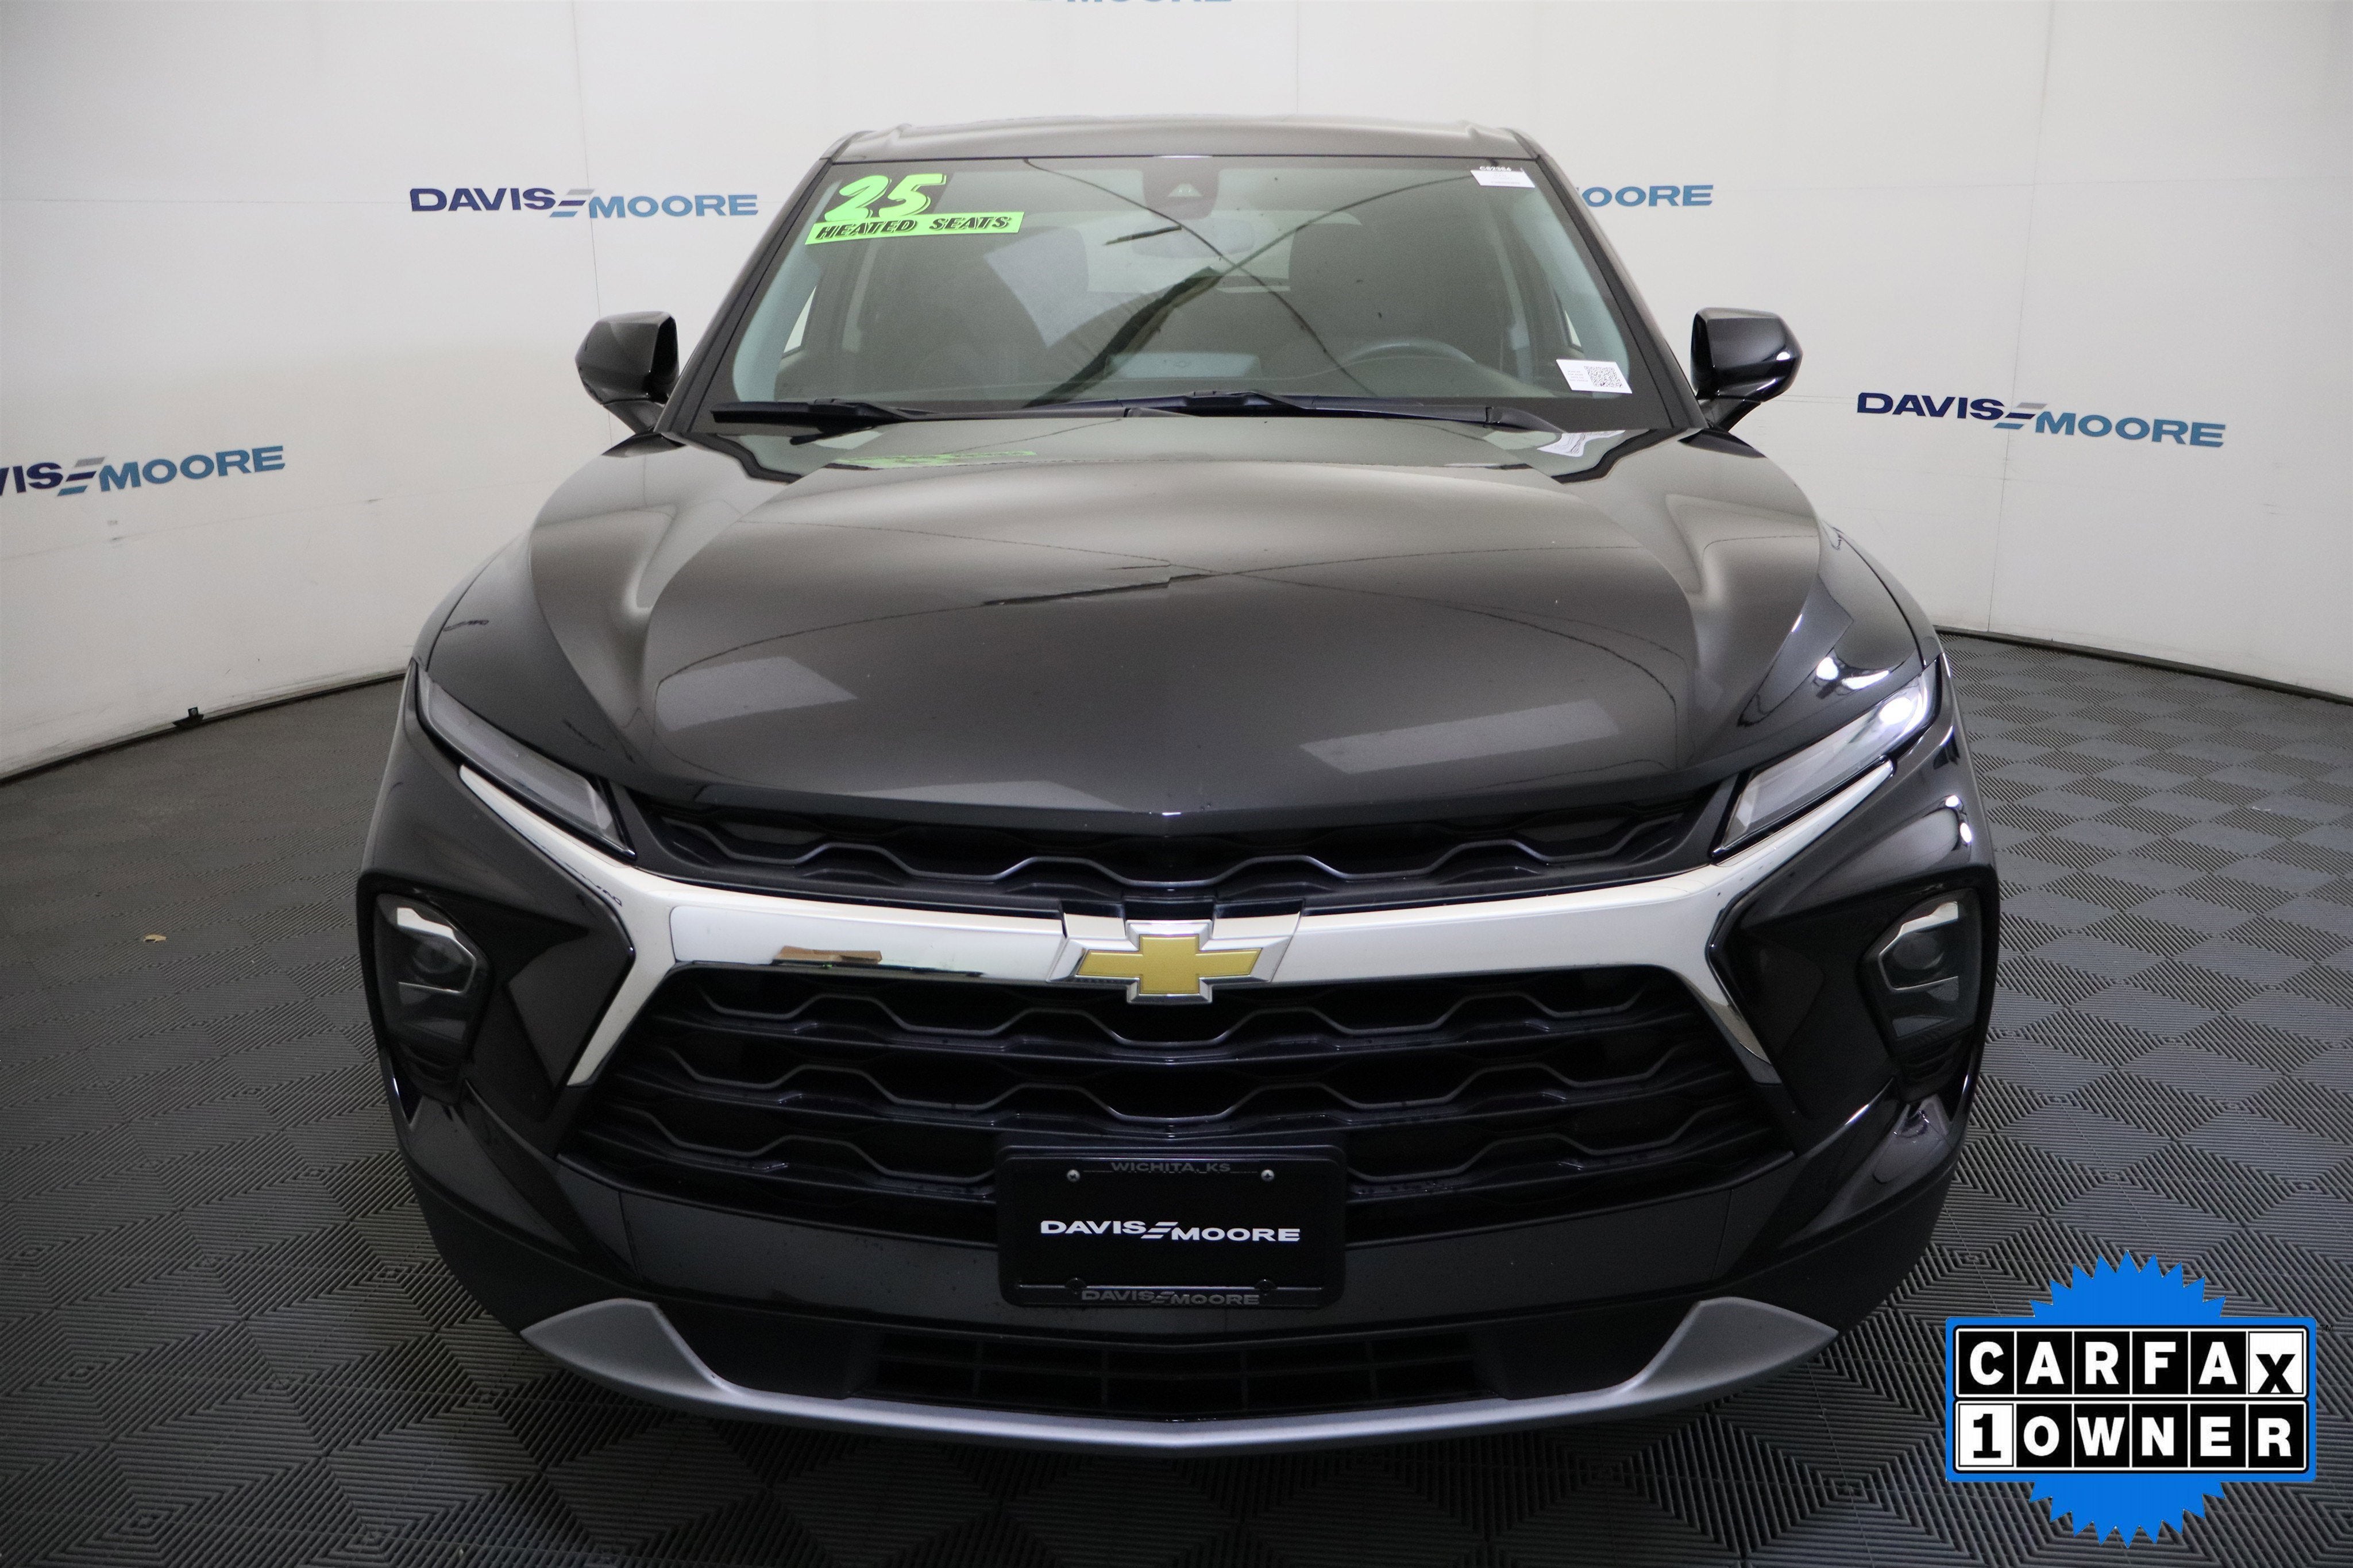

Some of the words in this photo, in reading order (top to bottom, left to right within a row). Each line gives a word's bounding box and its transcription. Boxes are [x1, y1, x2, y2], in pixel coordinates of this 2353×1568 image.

[410, 188, 555, 211] DAVIS
[589, 194, 758, 218] MOORE
[824, 173, 947, 222] 25
[1577, 184, 1714, 207] OORE
[815, 219, 918, 240] HEATED
[929, 216, 1011, 230] SEATS
[1857, 392, 2005, 420] DAVIS
[2035, 411, 2226, 448] MOORE
[99, 446, 286, 492] MOORE
[1206, 1163, 1230, 1172] KS
[1040, 1221, 1147, 1235] DAVIS
[1171, 1227, 1301, 1242] MOORE
[1081, 1290, 1155, 1301] DAVIS
[1170, 1294, 1260, 1305] MOORE
